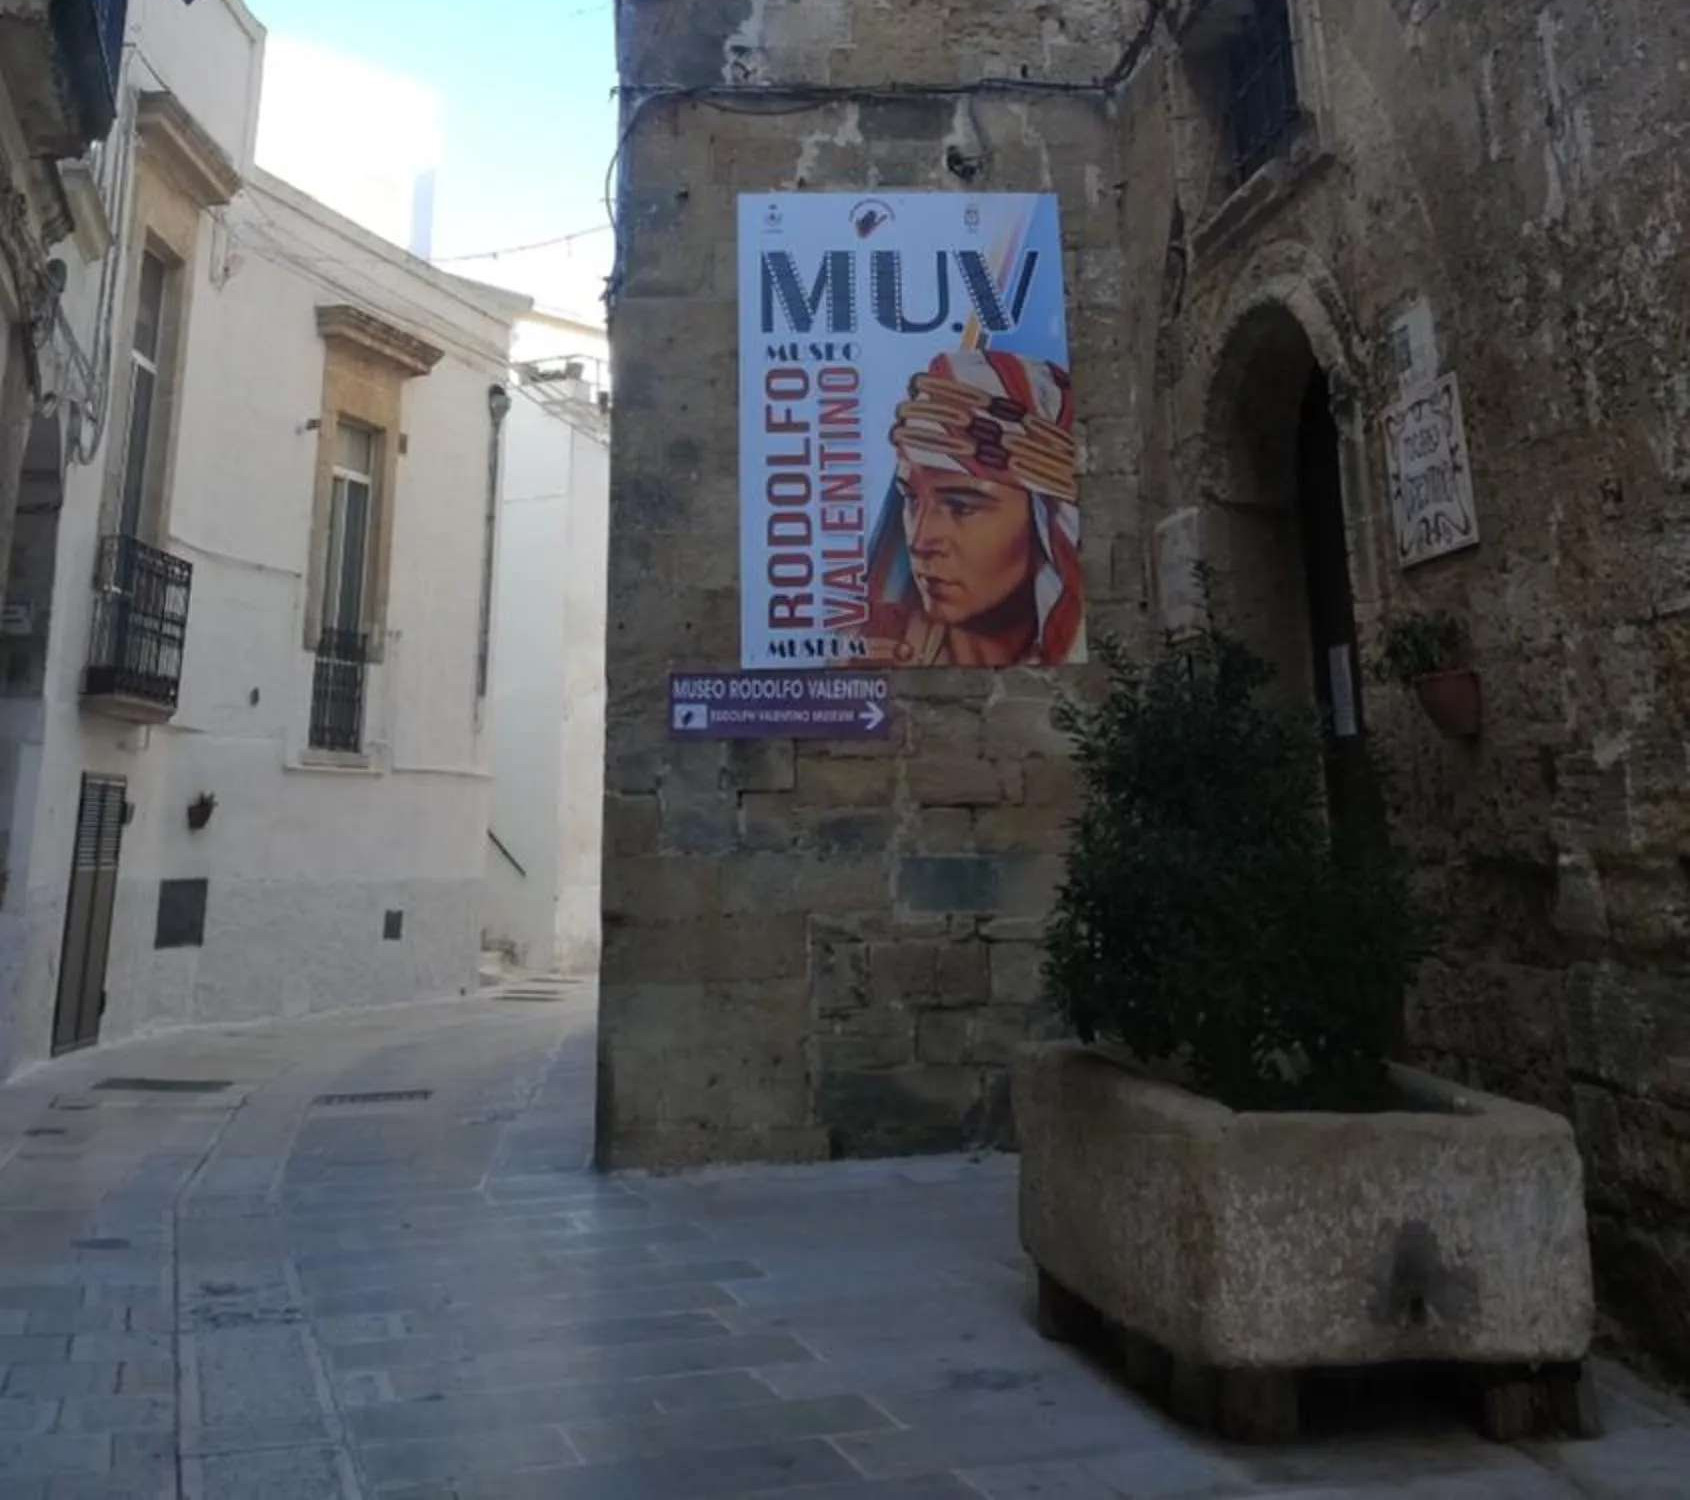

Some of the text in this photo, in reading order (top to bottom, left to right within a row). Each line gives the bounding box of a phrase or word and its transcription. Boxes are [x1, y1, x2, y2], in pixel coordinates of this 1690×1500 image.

[765, 342, 861, 361] MUSEO
[765, 368, 814, 629] RODOLFO
[817, 366, 867, 629] VALENTINO
[767, 638, 867, 658] MUSEUM
[673, 677, 888, 699] MUSEO RODOLFO VALENTINO
[758, 710, 810, 723] VALENTINO
[812, 710, 855, 722] MUSEUM
